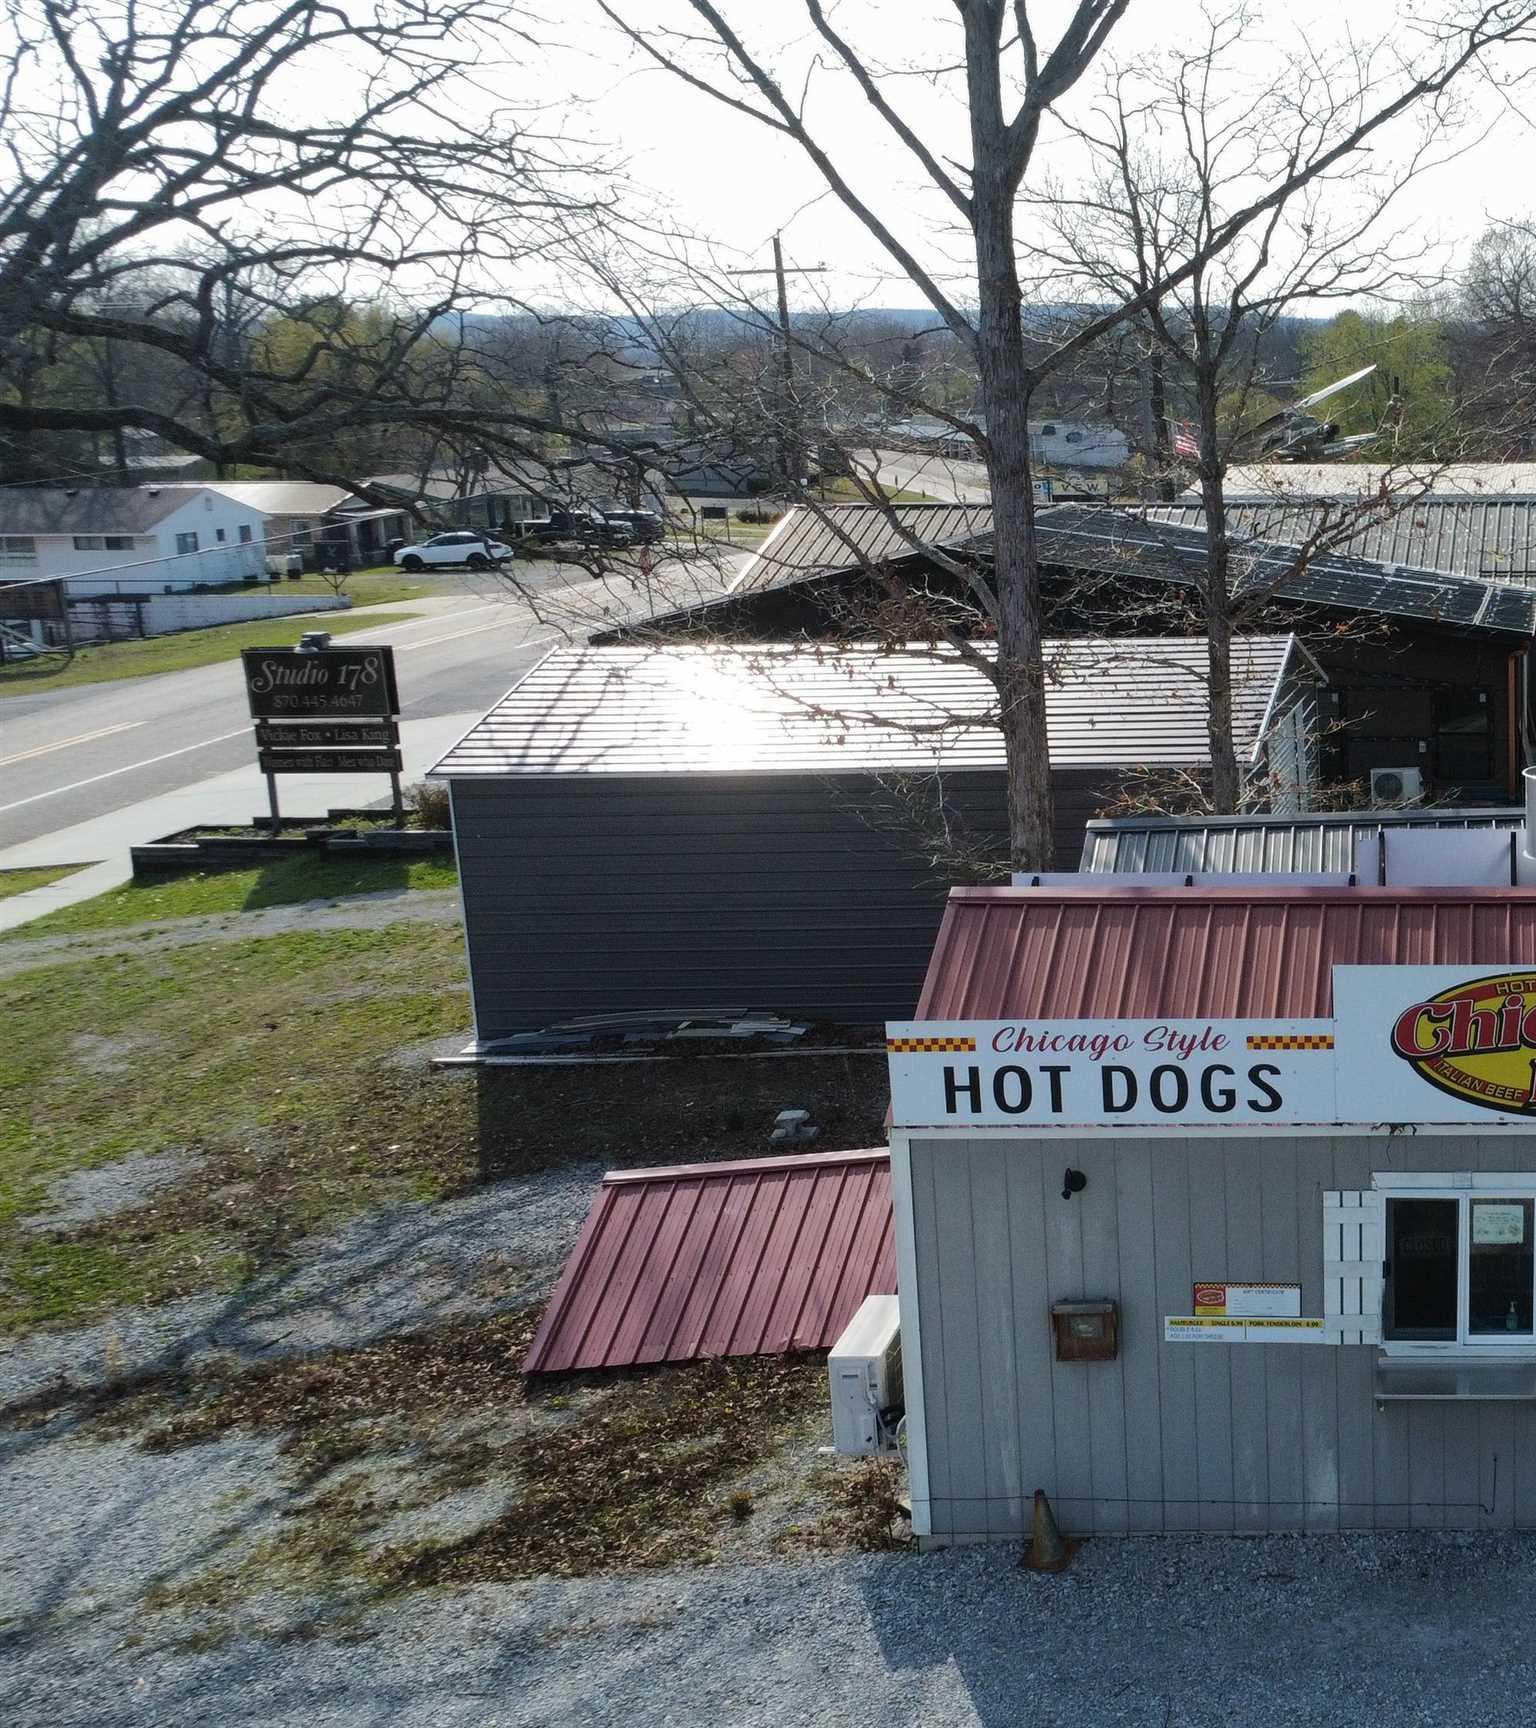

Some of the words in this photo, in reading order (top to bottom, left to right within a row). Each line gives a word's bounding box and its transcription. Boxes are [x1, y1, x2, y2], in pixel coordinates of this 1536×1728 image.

[252, 660, 328, 693] Studio
[337, 657, 378, 690] 178
[300, 728, 322, 740] Fox
[335, 728, 358, 740] Lisa
[361, 727, 389, 744] King
[1496, 980, 1536, 995] HOT
[992, 1026, 1136, 1061] Chicago
[1143, 1026, 1231, 1061] Style
[943, 1064, 1072, 1114] HOT
[1101, 1063, 1283, 1113] DOGS
[1433, 1060, 1484, 1092] ITALIAN
[1484, 1084, 1525, 1101] BEEF
